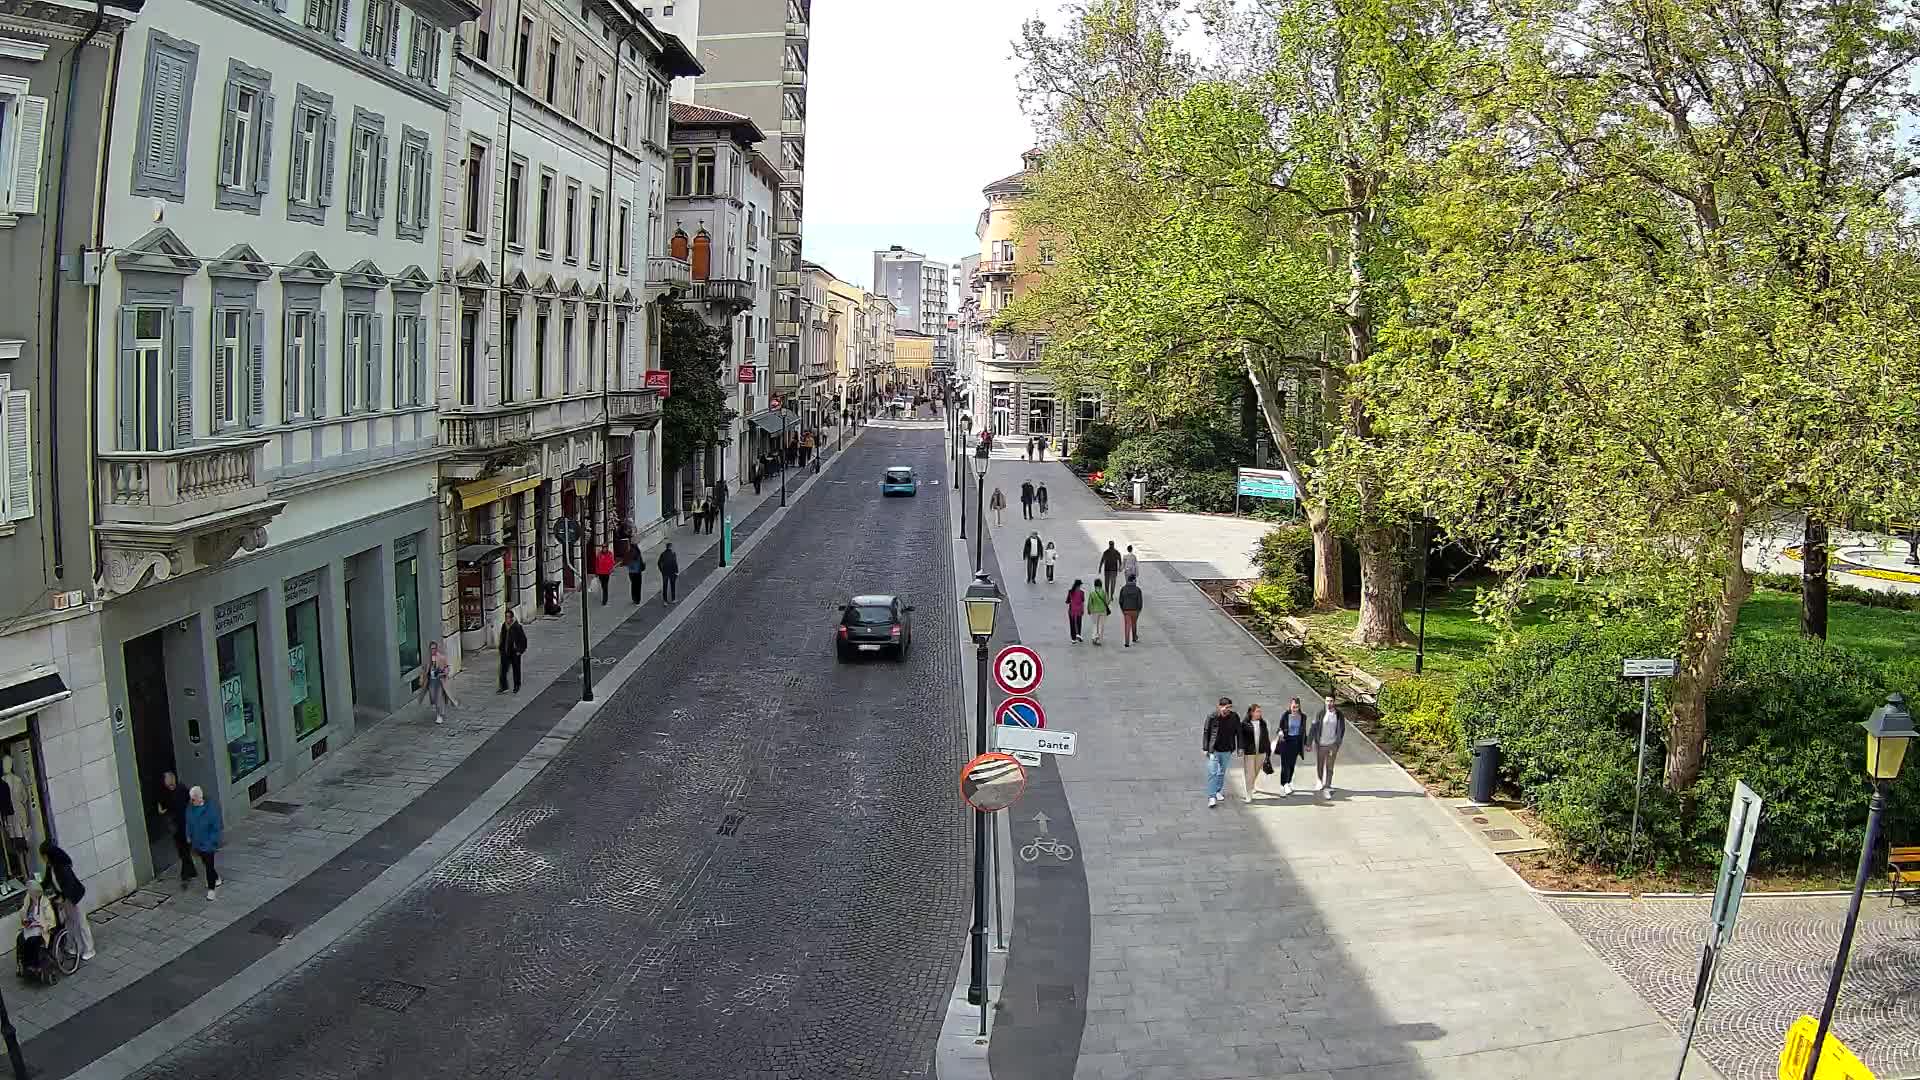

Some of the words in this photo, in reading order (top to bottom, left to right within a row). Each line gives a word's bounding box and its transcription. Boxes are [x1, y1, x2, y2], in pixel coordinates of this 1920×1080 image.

[1005, 660, 1033, 681] 30
[222, 679, 241, 702] 130
[1038, 739, 1069, 750] Dante
